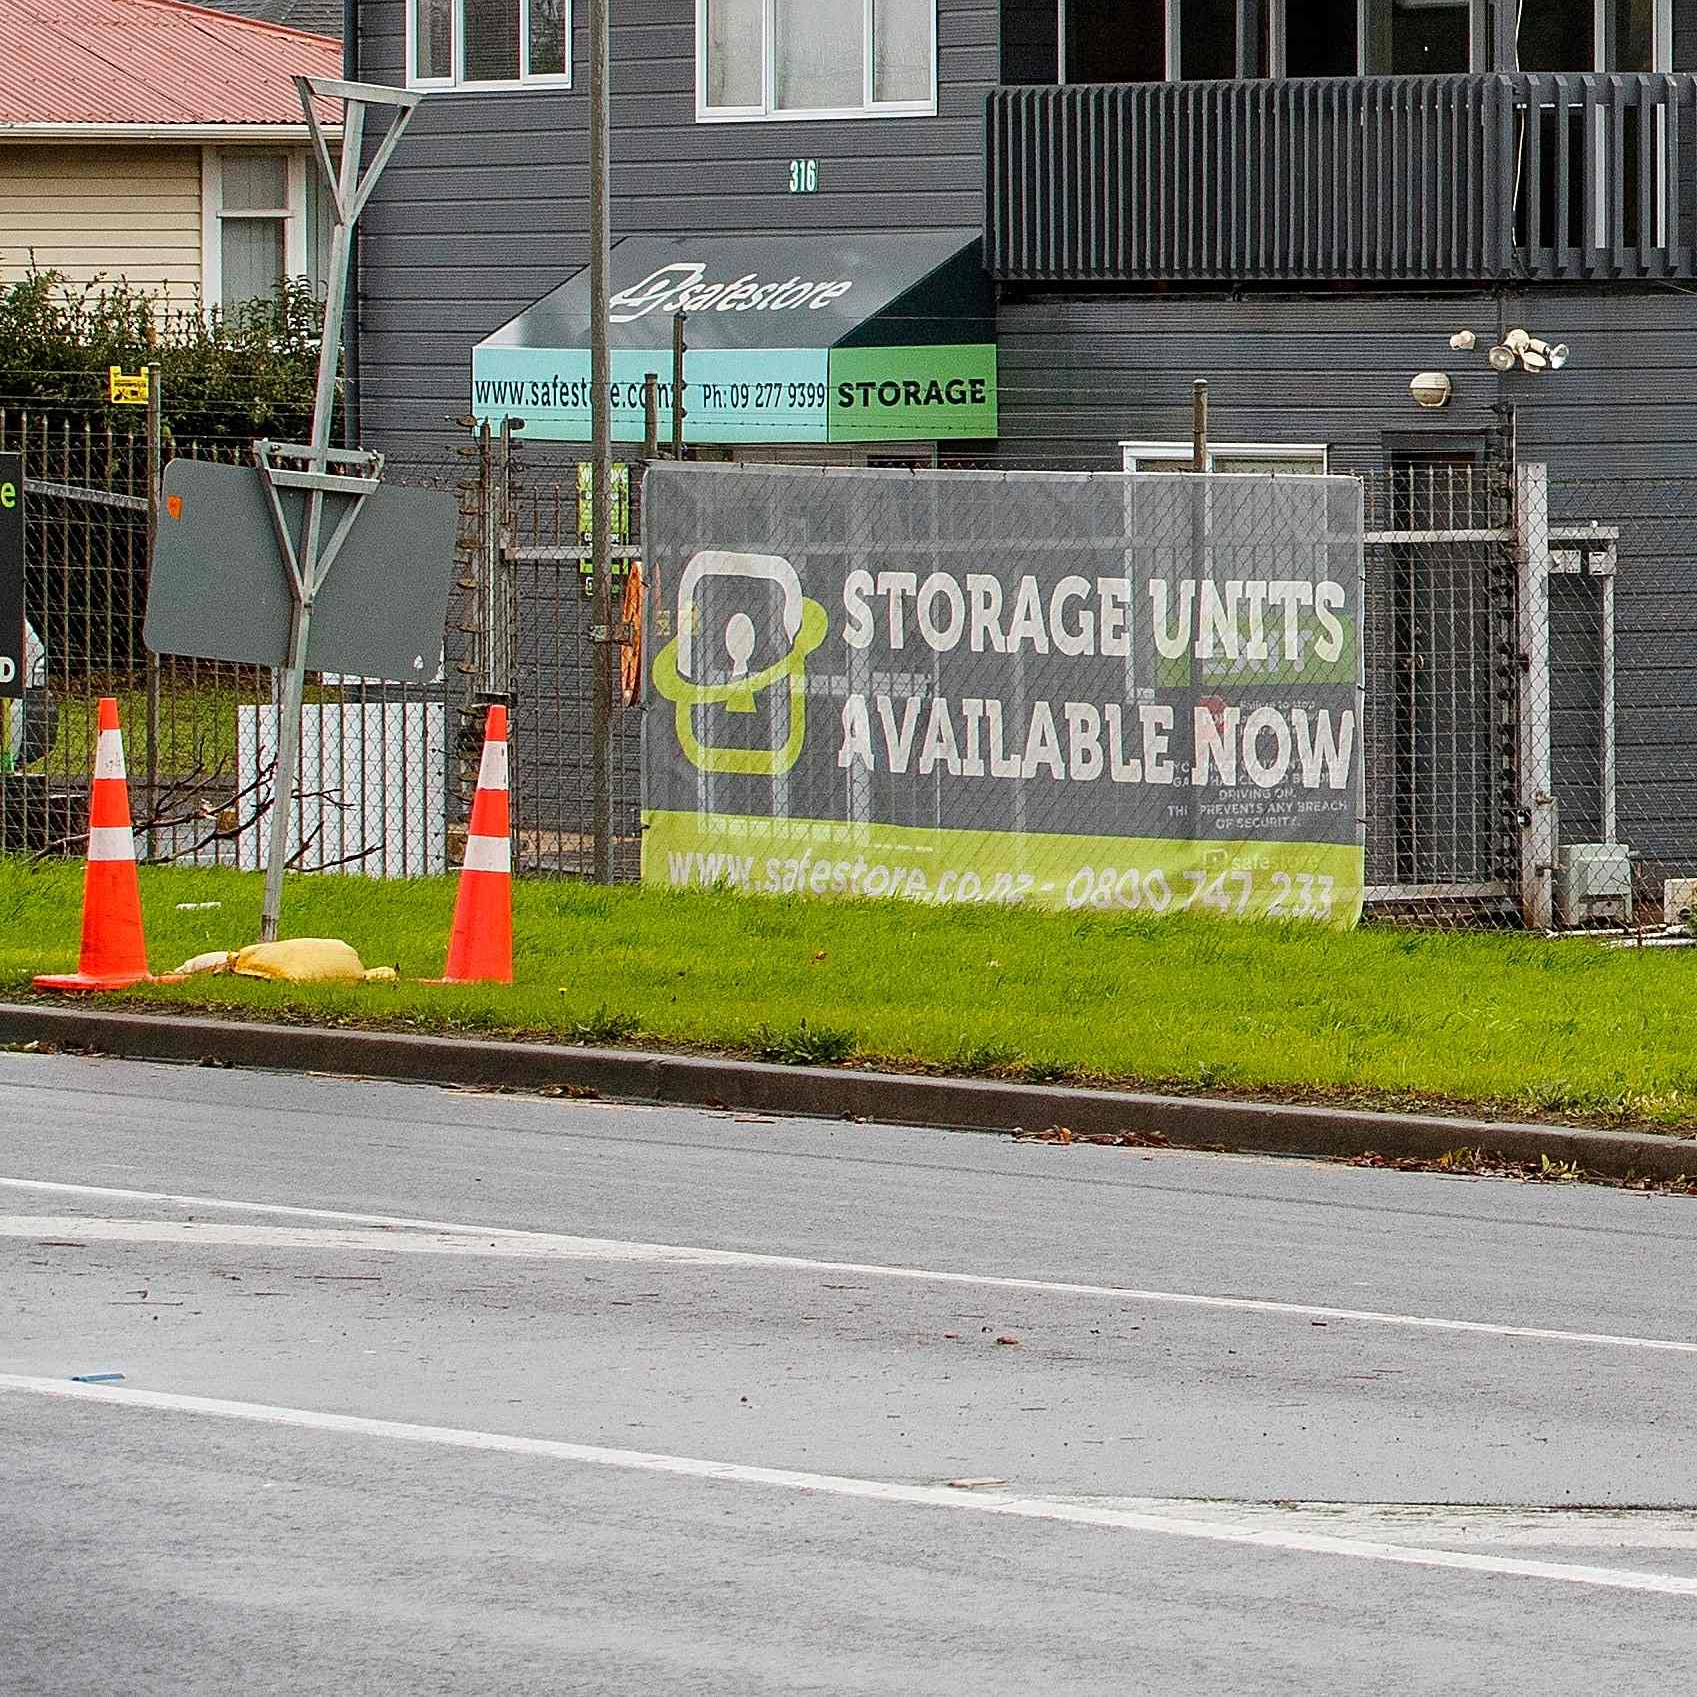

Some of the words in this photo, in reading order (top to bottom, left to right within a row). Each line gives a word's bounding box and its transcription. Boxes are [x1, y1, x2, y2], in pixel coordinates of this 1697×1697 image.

[789, 159, 817, 191] 316
[663, 273, 852, 311] safestore
[702, 383, 727, 408] Ph:
[730, 383, 749, 408] 09
[755, 383, 783, 408] 277
[788, 383, 825, 408] 9399
[838, 379, 986, 408] STORAGE
[841, 568, 1132, 657] STORAGE
[1149, 578, 1345, 664] UNITS
[838, 694, 1175, 785] AVAILABLE
[1191, 706, 1355, 790] NOW
[1167, 805, 1191, 817] THI
[1066, 866, 1173, 912] 0800
[1183, 869, 1253, 914] 747
[1267, 871, 1335, 919] 233
